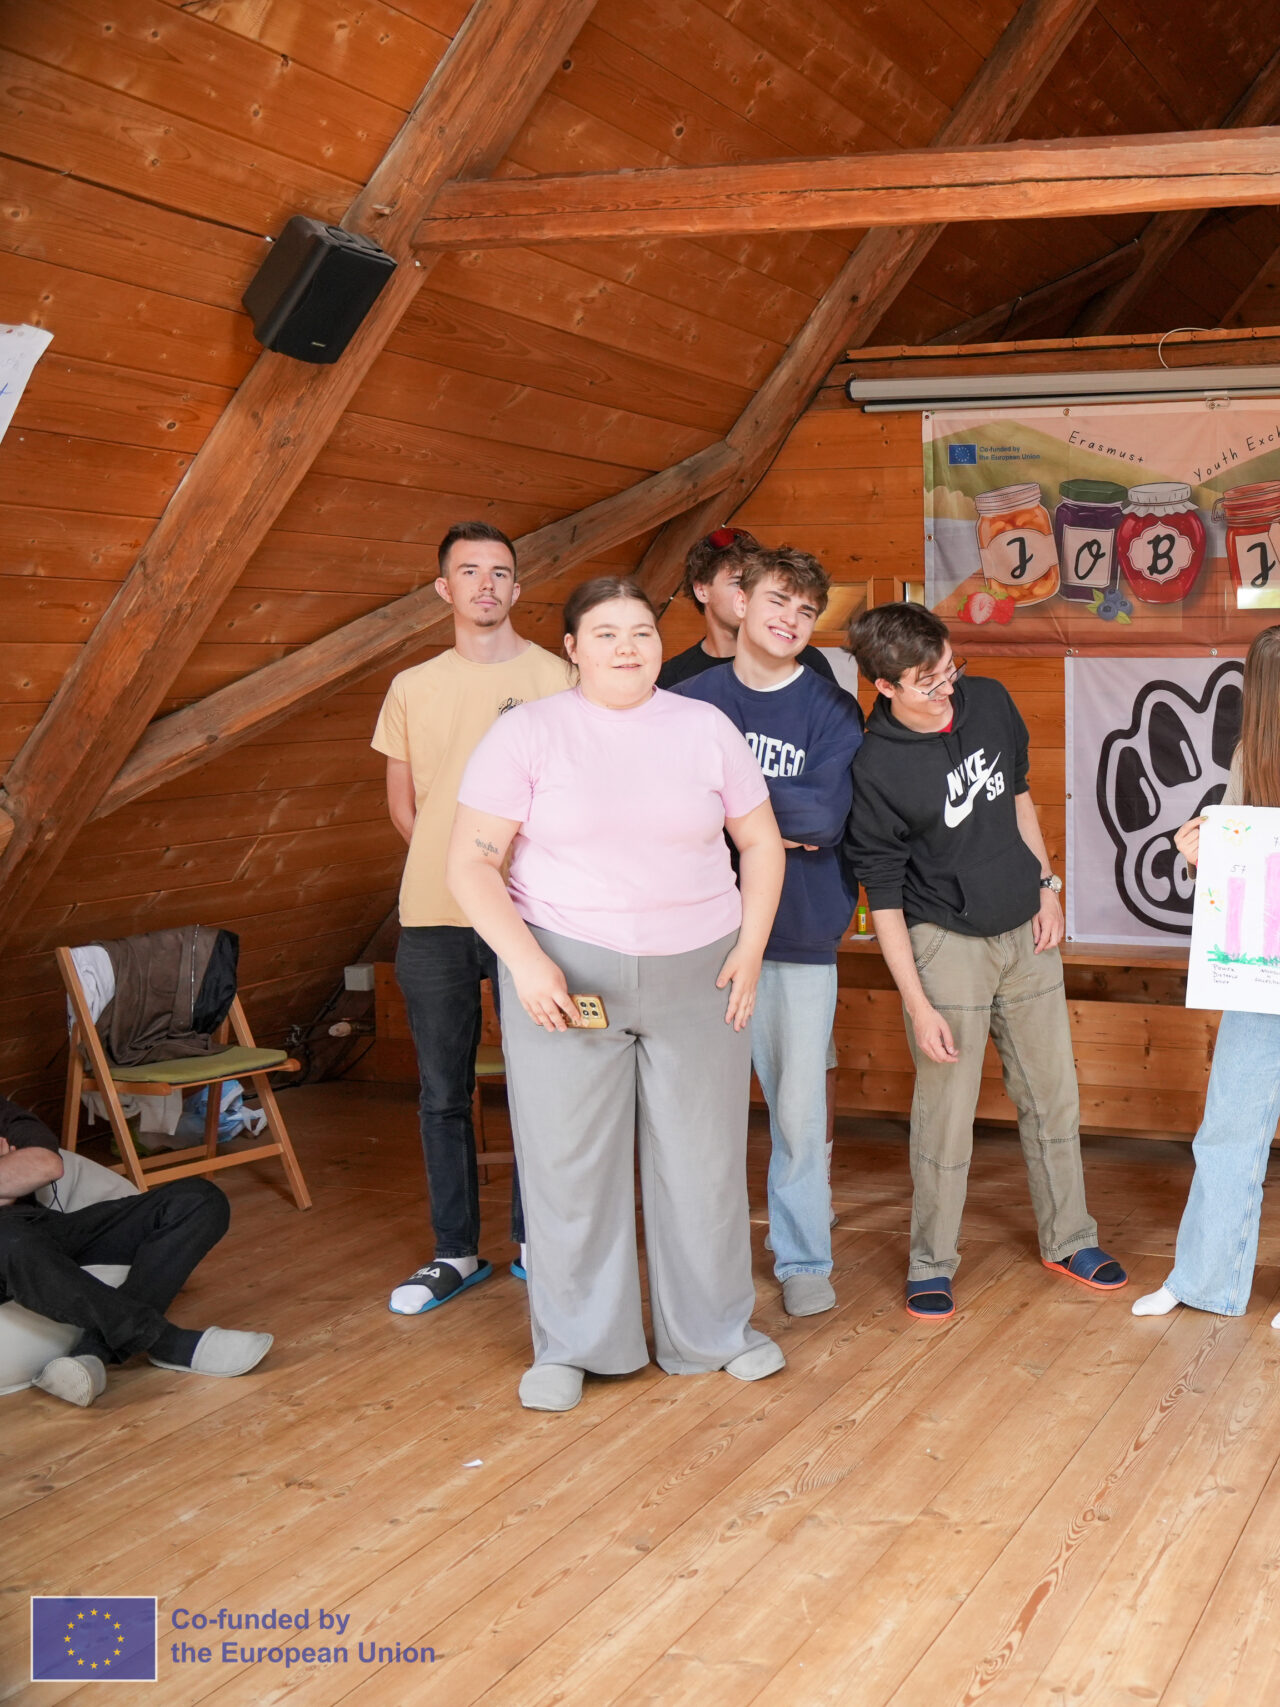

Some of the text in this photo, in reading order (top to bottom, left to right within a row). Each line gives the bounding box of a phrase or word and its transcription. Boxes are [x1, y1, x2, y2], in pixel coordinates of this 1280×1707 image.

[979, 453, 1041, 462] the European Union
[1067, 430, 1145, 464] Erasmus+
[1193, 451, 1238, 481] Youth
[946, 748, 987, 801] NIKE
[985, 771, 1005, 802] SB
